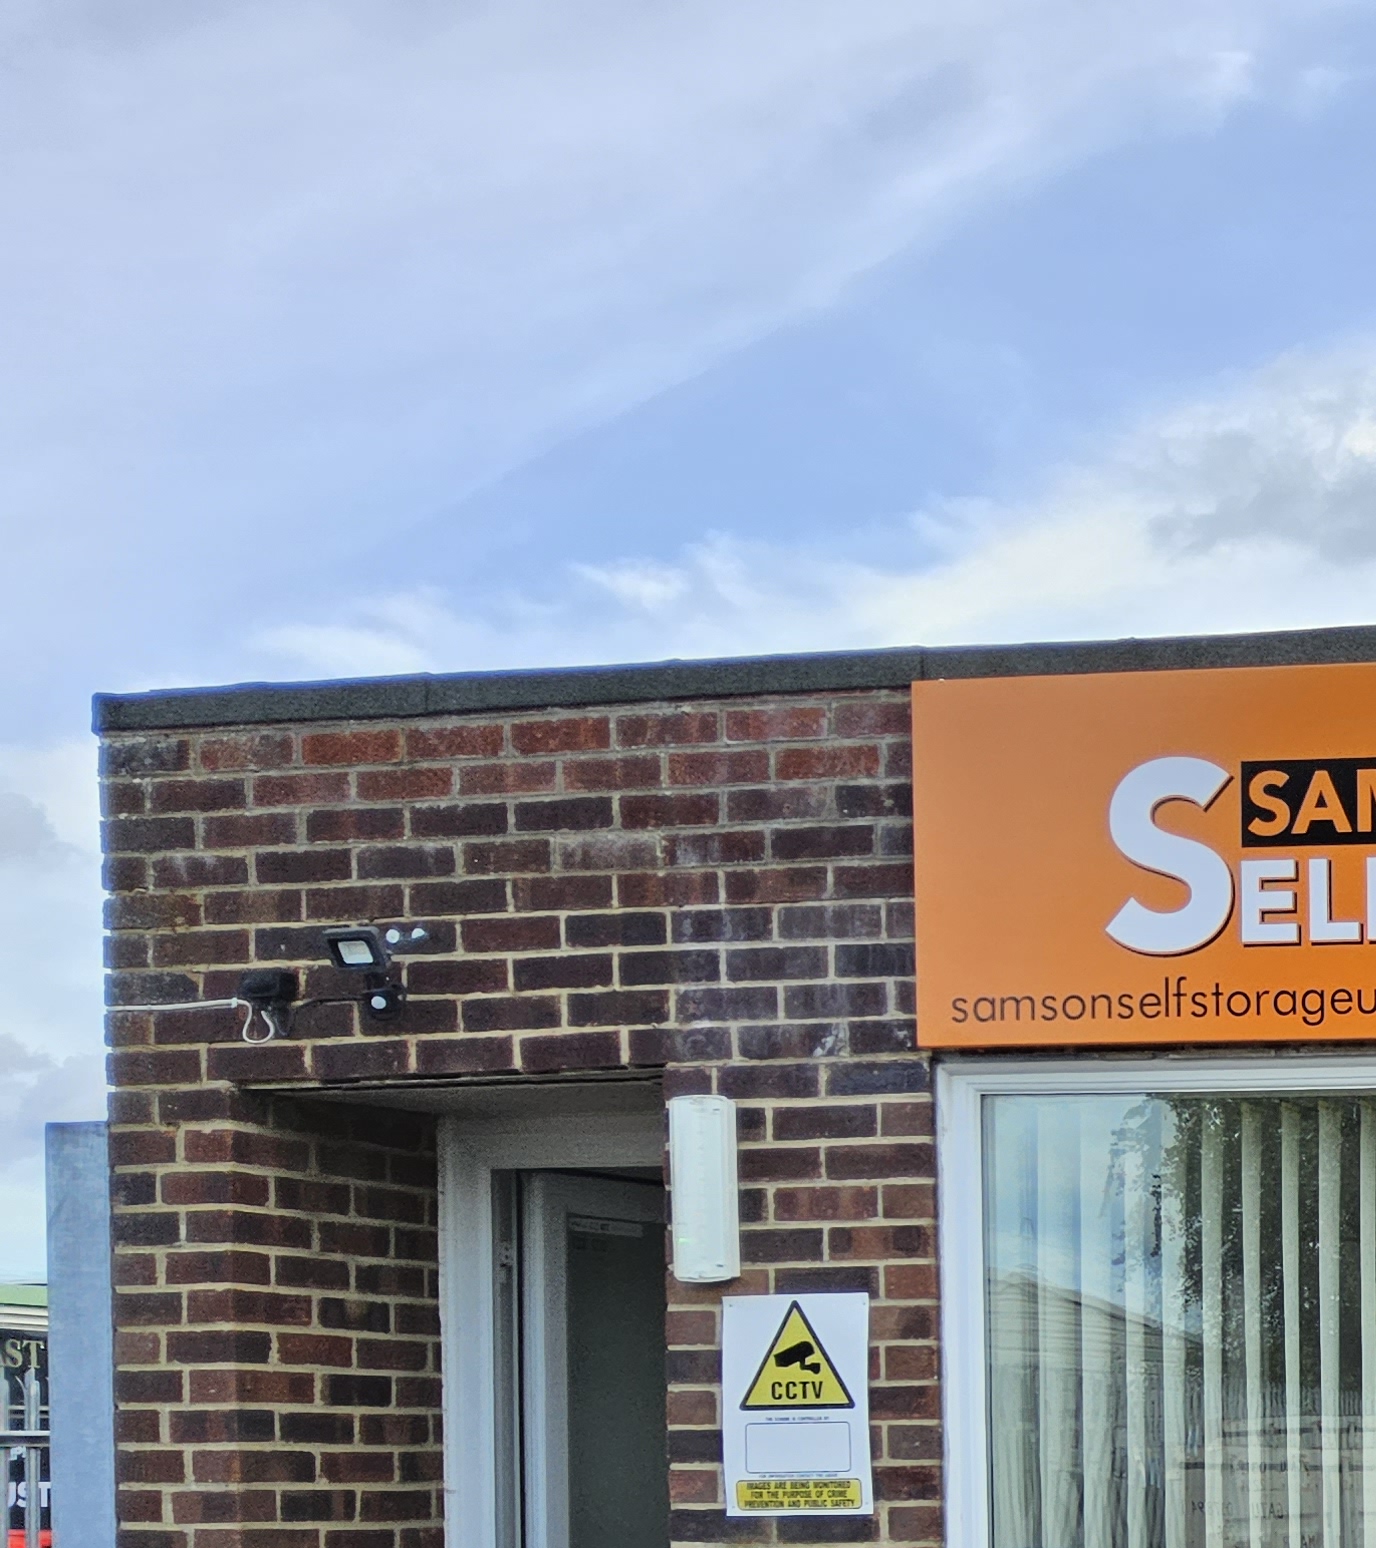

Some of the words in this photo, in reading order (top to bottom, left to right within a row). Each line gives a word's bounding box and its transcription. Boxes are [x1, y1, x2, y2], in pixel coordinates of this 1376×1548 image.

[0, 1339, 45, 1369] ST
[771, 1381, 823, 1400] CCTV
[751, 1491, 763, 1499] FOR
[767, 1491, 779, 1499] THE
[815, 1490, 823, 1498] OF
[788, 1500, 801, 1508] AND
[830, 1499, 855, 1507] SAFETY
